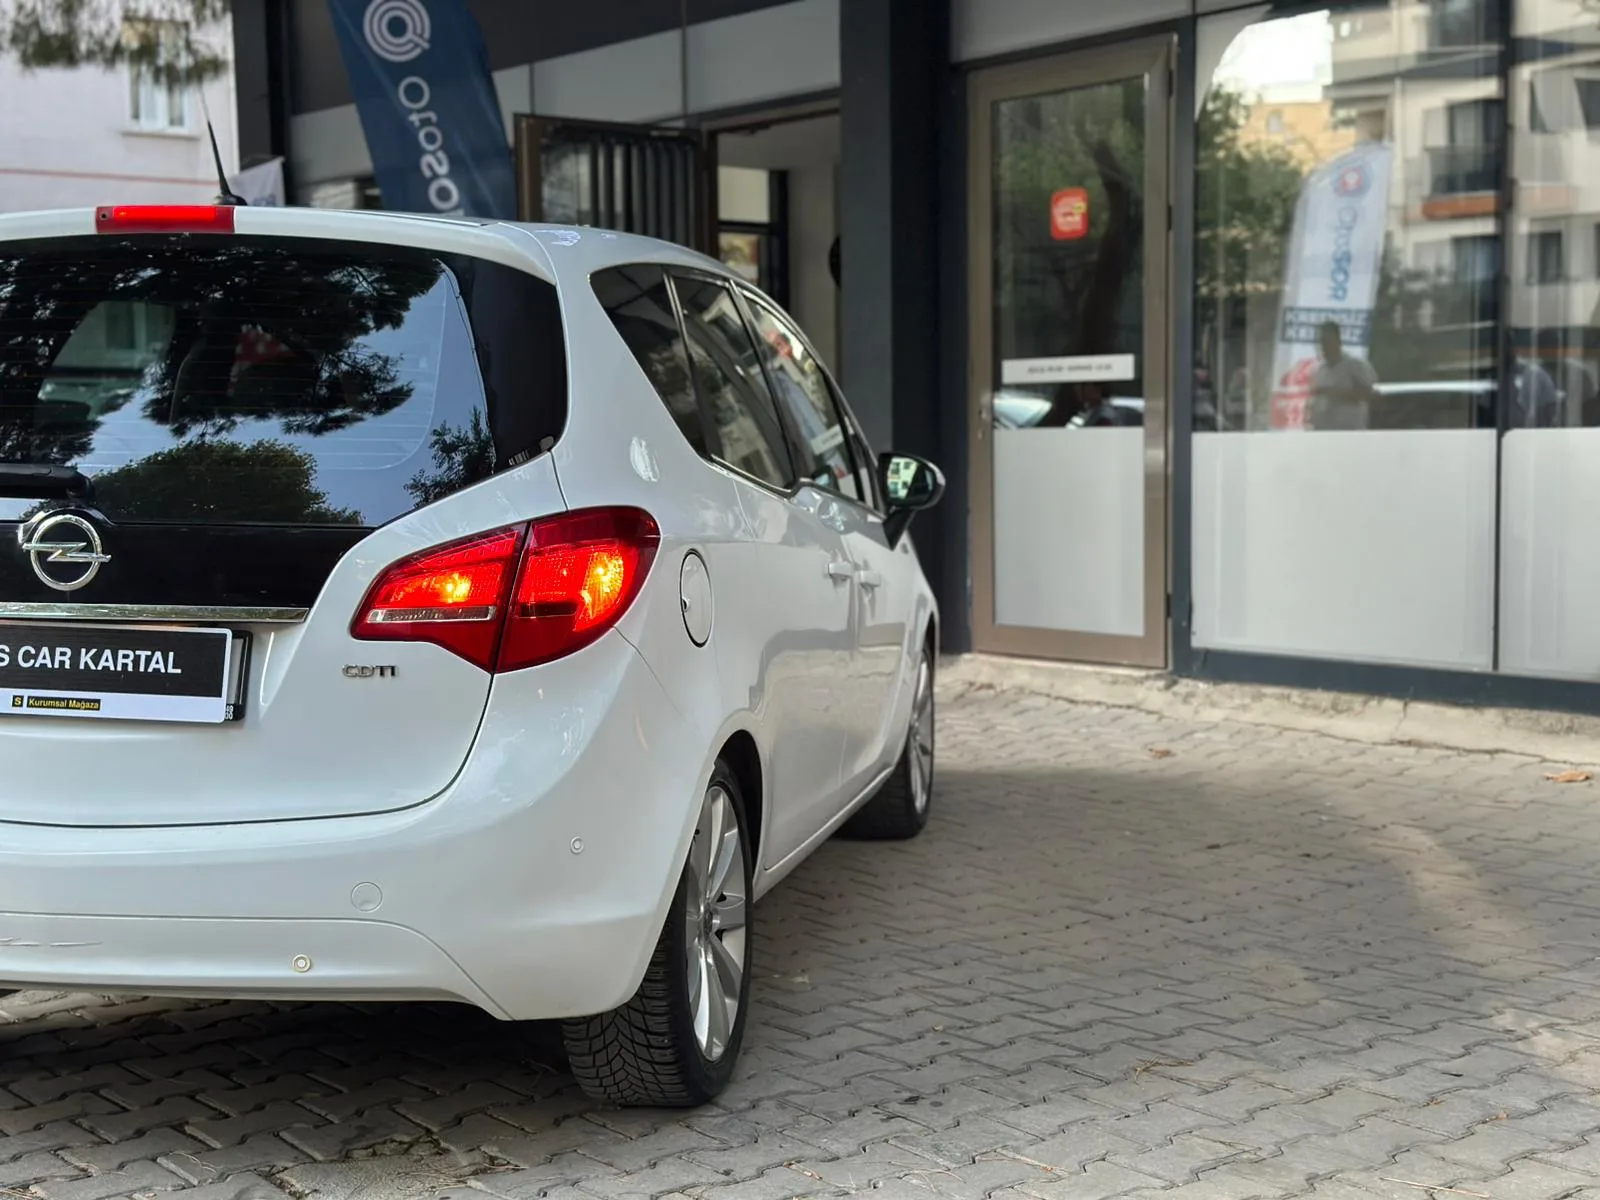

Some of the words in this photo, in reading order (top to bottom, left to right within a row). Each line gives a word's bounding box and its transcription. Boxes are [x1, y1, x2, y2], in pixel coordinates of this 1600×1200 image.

[18, 646, 71, 670] CAR
[79, 648, 182, 674] KARTAL
[28, 697, 67, 708] Kurumsal
